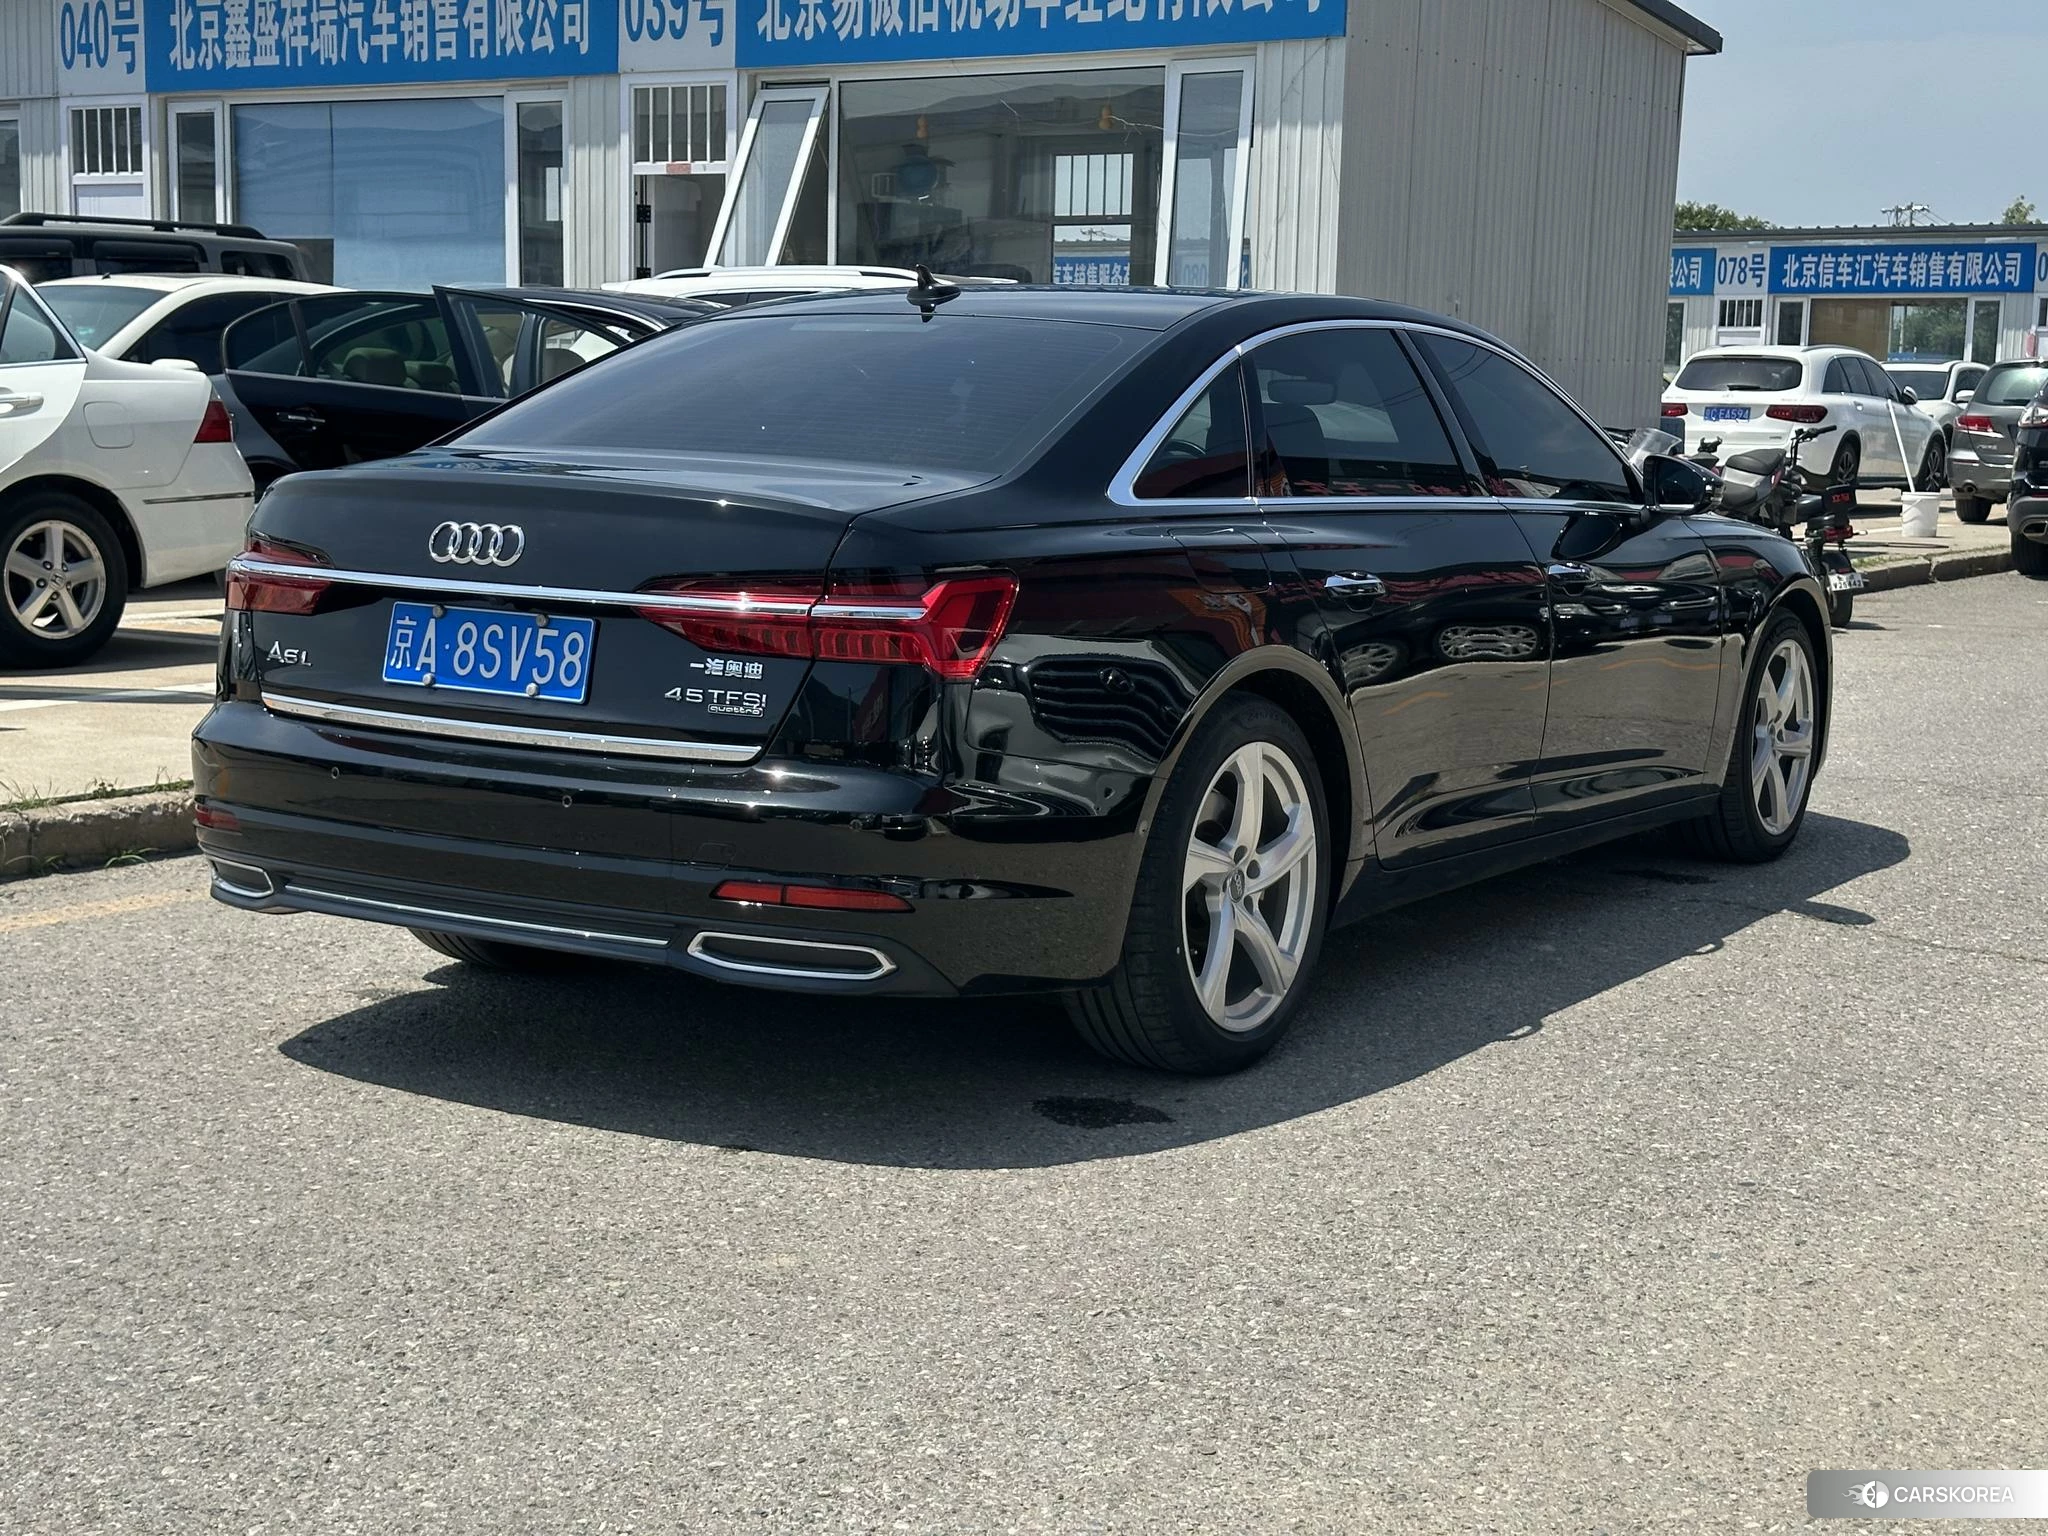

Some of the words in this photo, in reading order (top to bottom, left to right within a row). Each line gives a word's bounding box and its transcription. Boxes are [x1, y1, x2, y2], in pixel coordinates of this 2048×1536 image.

[60, 0, 139, 74] 040号
[169, 0, 590, 72] 北京鑫盛祥瑞汽车销售有限公司
[1717, 253, 1766, 288] 078号
[1781, 251, 2022, 288] 北京信车汇汽车销售有限公司
[389, 615, 585, 688] 京A·8SV58
[689, 657, 763, 679] 一汽奥迪
[664, 687, 704, 703] 45
[707, 689, 767, 709] TFSI
[709, 705, 760, 715] quattro
